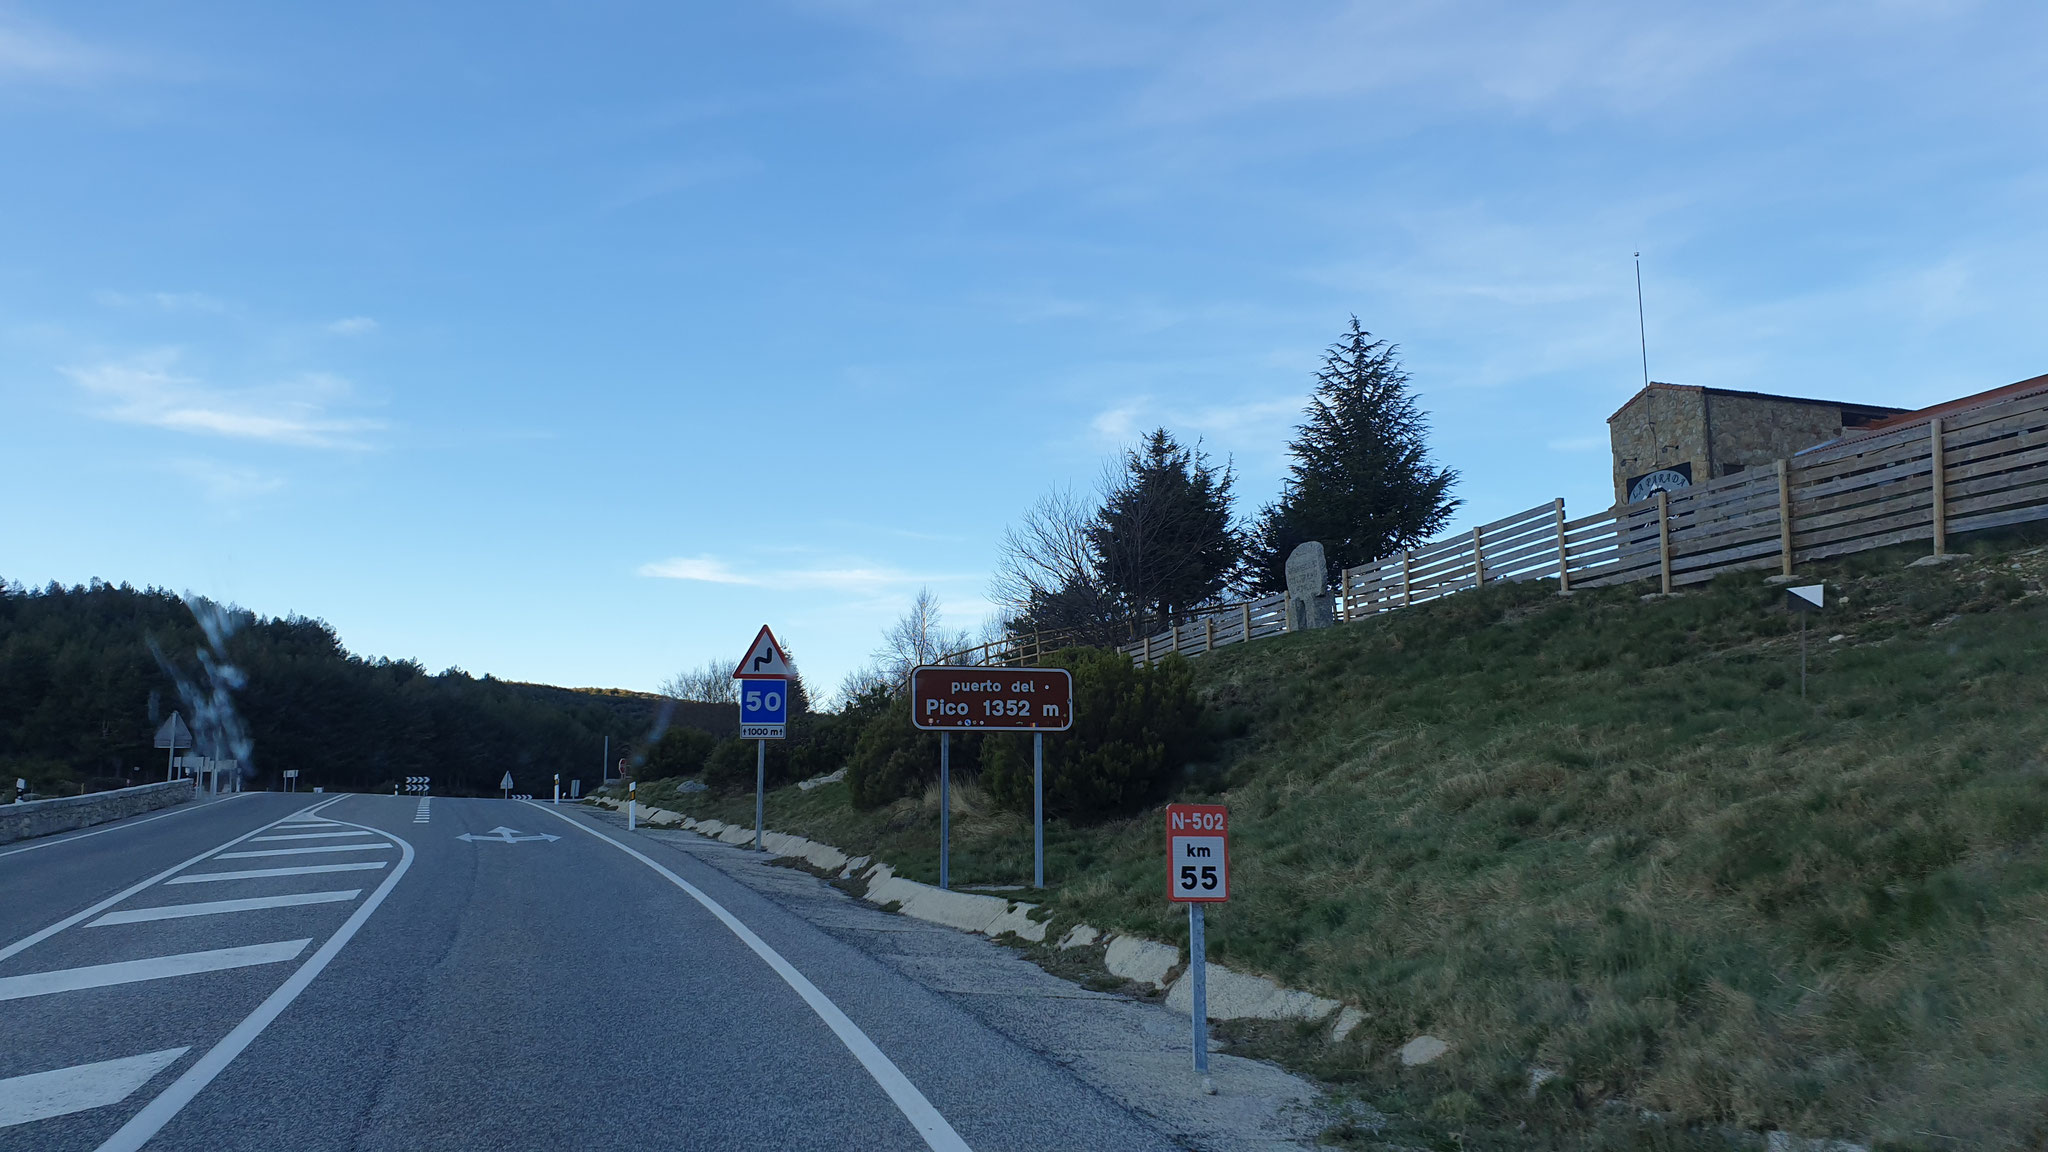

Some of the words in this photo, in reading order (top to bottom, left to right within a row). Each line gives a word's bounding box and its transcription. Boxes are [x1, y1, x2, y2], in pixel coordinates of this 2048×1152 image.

[1632, 484, 1644, 499] LA
[1646, 473, 1686, 487] PARADA
[952, 680, 1001, 694] puerto
[1011, 680, 1035, 692] del
[745, 691, 781, 712] 50
[926, 698, 969, 715] Pico
[983, 699, 1030, 716] 1352
[1042, 703, 1059, 716] m
[748, 728, 768, 736] 1000
[1172, 812, 1224, 830] N-502
[1187, 843, 1211, 857] km
[1181, 865, 1218, 890] 55
